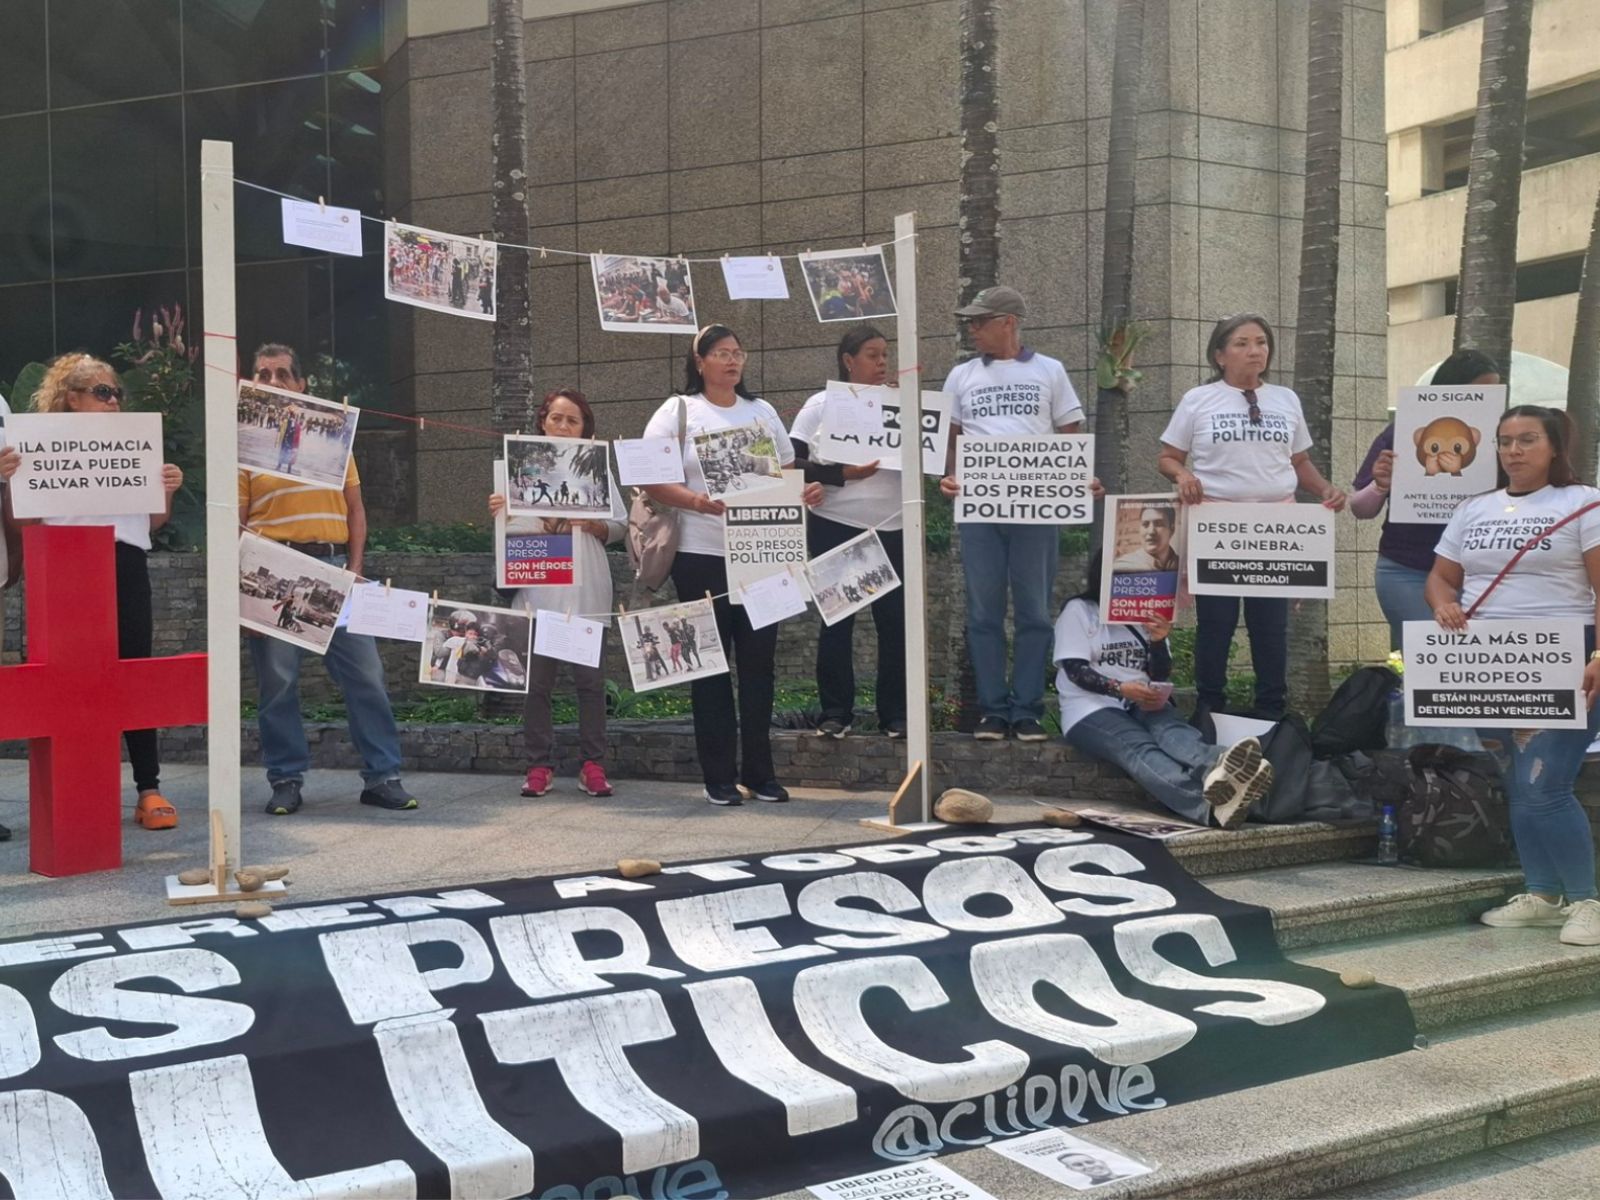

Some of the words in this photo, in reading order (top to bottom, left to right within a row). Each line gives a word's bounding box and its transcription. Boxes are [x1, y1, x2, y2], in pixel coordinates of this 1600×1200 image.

[1014, 384, 1040, 392] TODOS
[971, 394, 992, 406] LOS
[996, 392, 1040, 402] PRESOS
[1418, 393, 1438, 402] NO
[1442, 393, 1484, 402] SIGAN
[1212, 420, 1237, 430] LOS
[19, 441, 46, 453] ¡LA
[52, 440, 152, 452] DIPLOMACIA
[962, 442, 1073, 453] SOLIDARIDAD
[1077, 442, 1087, 452] Y
[33, 460, 83, 471] SUIZA
[88, 458, 141, 470] PUEDE
[963, 456, 1088, 468] DIPLOMACIA
[963, 472, 988, 480] POR
[991, 472, 1006, 480] LA
[1010, 472, 1067, 480] LIBERTAD
[1070, 472, 1087, 480] DE
[29, 477, 89, 490] SALVAR
[95, 476, 148, 488] VIDAS!
[963, 484, 1000, 497] LOS
[1007, 484, 1086, 498] PRESOS
[728, 508, 799, 521] LIBERTAD
[962, 500, 1086, 519] POLÍTICOS
[1521, 517, 1555, 525] TODOS
[728, 528, 760, 538] PARA
[760, 528, 803, 538] TODOS
[1197, 522, 1248, 534] DESDE
[1253, 524, 1326, 535] CARACAS
[508, 540, 524, 548] NO
[526, 540, 548, 548] SON
[728, 540, 752, 551] LOS
[756, 540, 804, 550] PRESOS
[1215, 540, 1225, 550] A
[1230, 540, 1304, 551] GINEBRA:
[508, 550, 548, 558] PRESOS
[730, 549, 804, 564] POLÍTICOS
[507, 562, 530, 570] SON
[532, 560, 574, 570] HÉROES
[1208, 560, 1264, 571] ¡EXIGIMOS
[1266, 562, 1315, 572] JUSTICIA
[508, 571, 546, 580] CIVILES
[1114, 576, 1132, 586] NO
[1134, 576, 1157, 586] SON
[1232, 574, 1240, 583] Y
[1242, 574, 1289, 584] VERDAD!
[1113, 586, 1157, 596] PRESOS
[1111, 598, 1136, 608] SON
[1426, 634, 1482, 646] SUIZA
[1488, 631, 1528, 645] MÁS
[1536, 633, 1560, 644] DE
[1416, 653, 1438, 664] 30
[1444, 652, 1572, 664] CIUDADANOS
[1440, 672, 1542, 684] EUROPEOS
[1432, 692, 1467, 702] ESTÁN
[1470, 694, 1555, 703] INJUSTAMENTE
[1418, 706, 1481, 715] DETENIDOS
[1484, 706, 1500, 715] EN
[1502, 706, 1572, 716] VENEZUELA
[553, 876, 657, 899] A
[660, 828, 1096, 883] TODOS
[318, 843, 1177, 1025] PRESOS
[826, 1166, 931, 1192] LIBERDADE
[839, 1186, 880, 1200] PARA
[884, 1174, 942, 1195] TODOS
